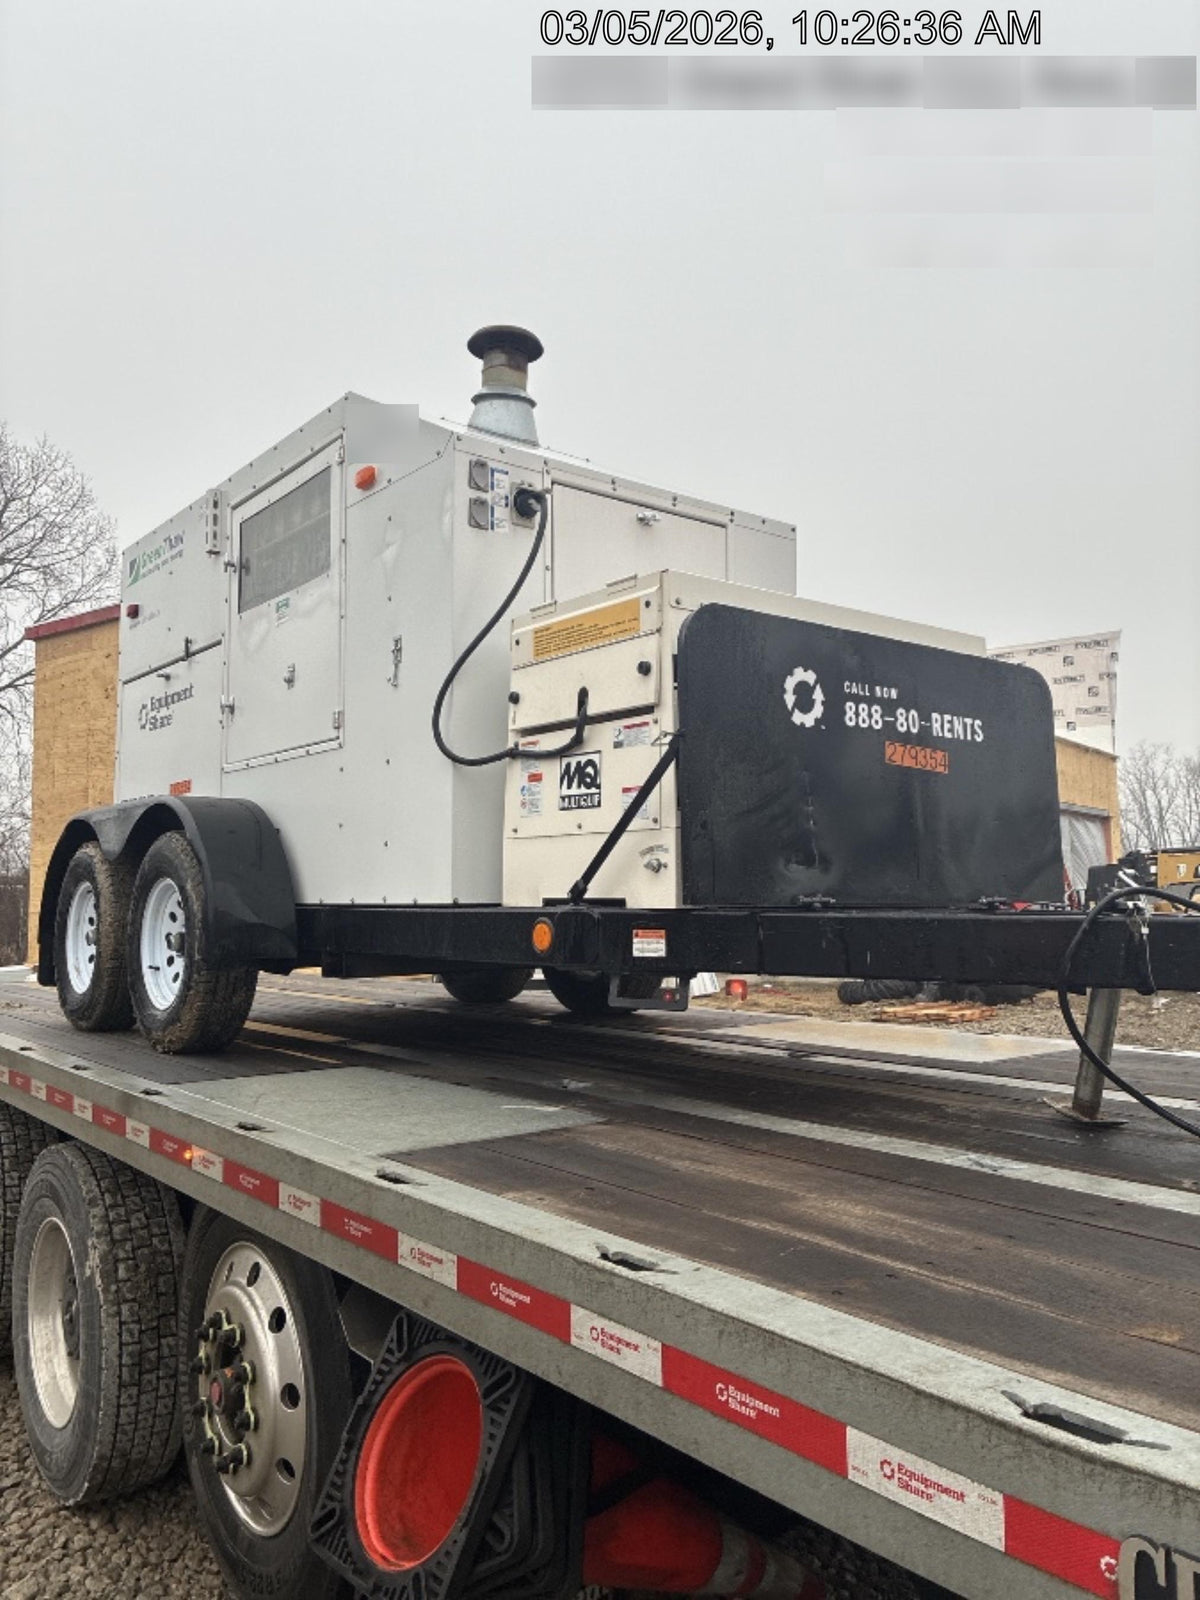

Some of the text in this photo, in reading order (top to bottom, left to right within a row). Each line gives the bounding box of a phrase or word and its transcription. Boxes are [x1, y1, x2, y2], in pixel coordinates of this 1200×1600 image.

[150, 682, 194, 713] Equipment
[844, 681, 898, 699] CALL NOW
[148, 713, 174, 731] Share
[845, 702, 984, 742] 888-80-RENTS
[887, 743, 948, 772] 279354
[560, 759, 600, 790] MQ
[728, 1384, 779, 1418] Equipment
[728, 1396, 757, 1419] Share
[897, 1462, 966, 1504] Equipment
[897, 1477, 932, 1503] Share
